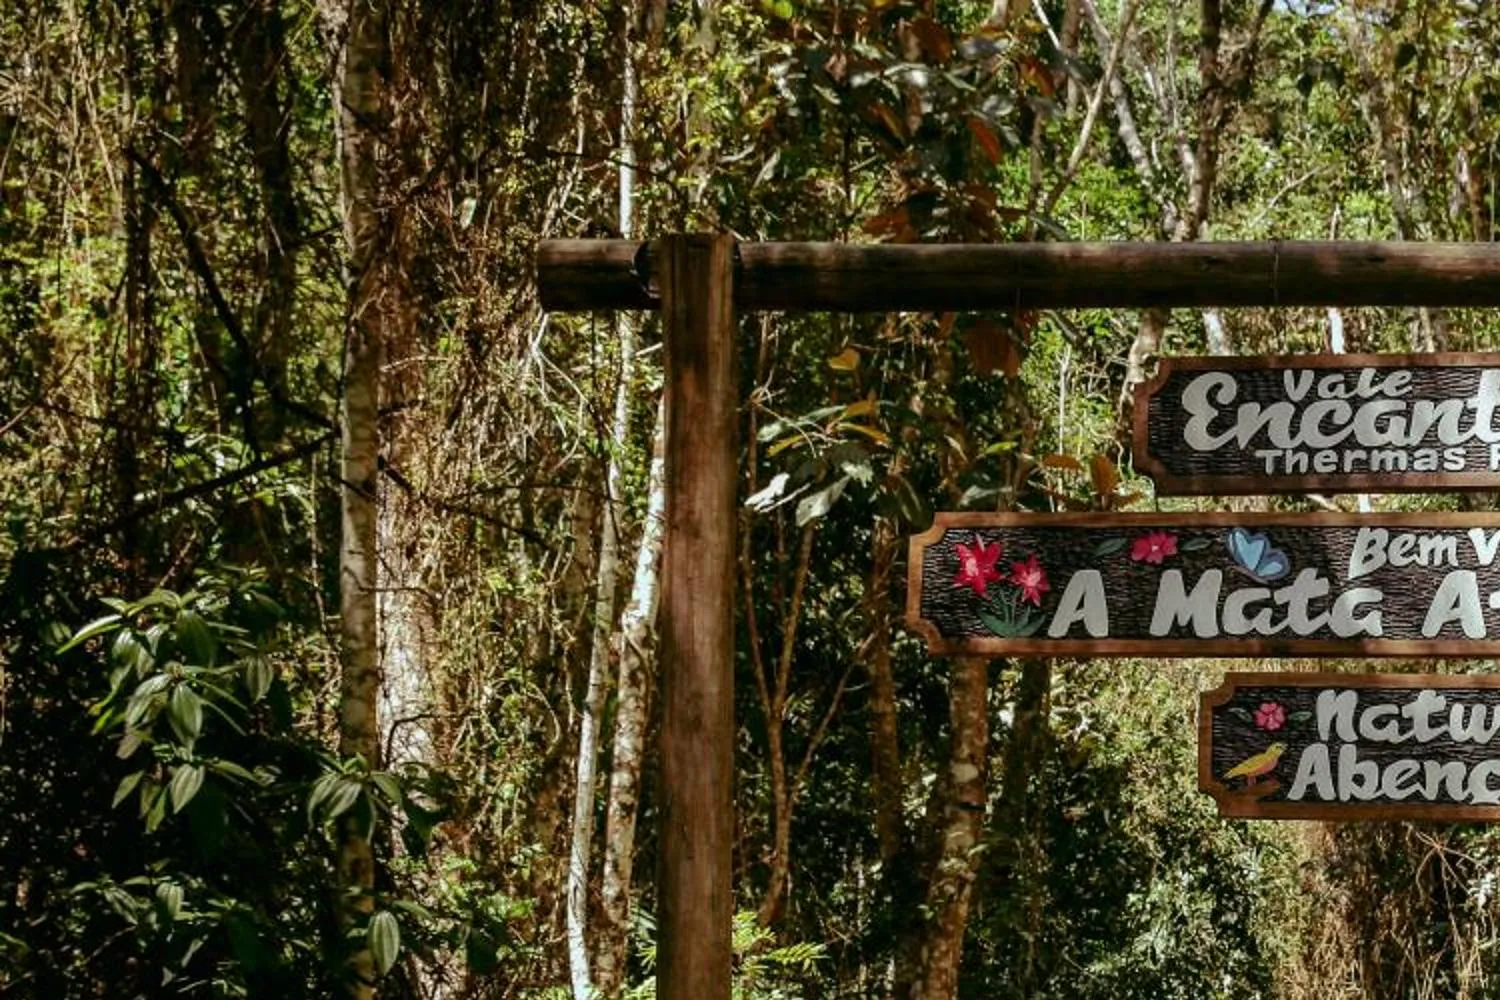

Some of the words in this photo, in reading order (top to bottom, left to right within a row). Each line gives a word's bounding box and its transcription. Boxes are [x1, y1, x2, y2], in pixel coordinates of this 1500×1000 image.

[1284, 368, 1413, 399] Vale
[1258, 448, 1466, 474] Thermas
[1348, 528, 1459, 579] Bem
[1048, 570, 1109, 637] A
[1150, 569, 1383, 636] Mata
